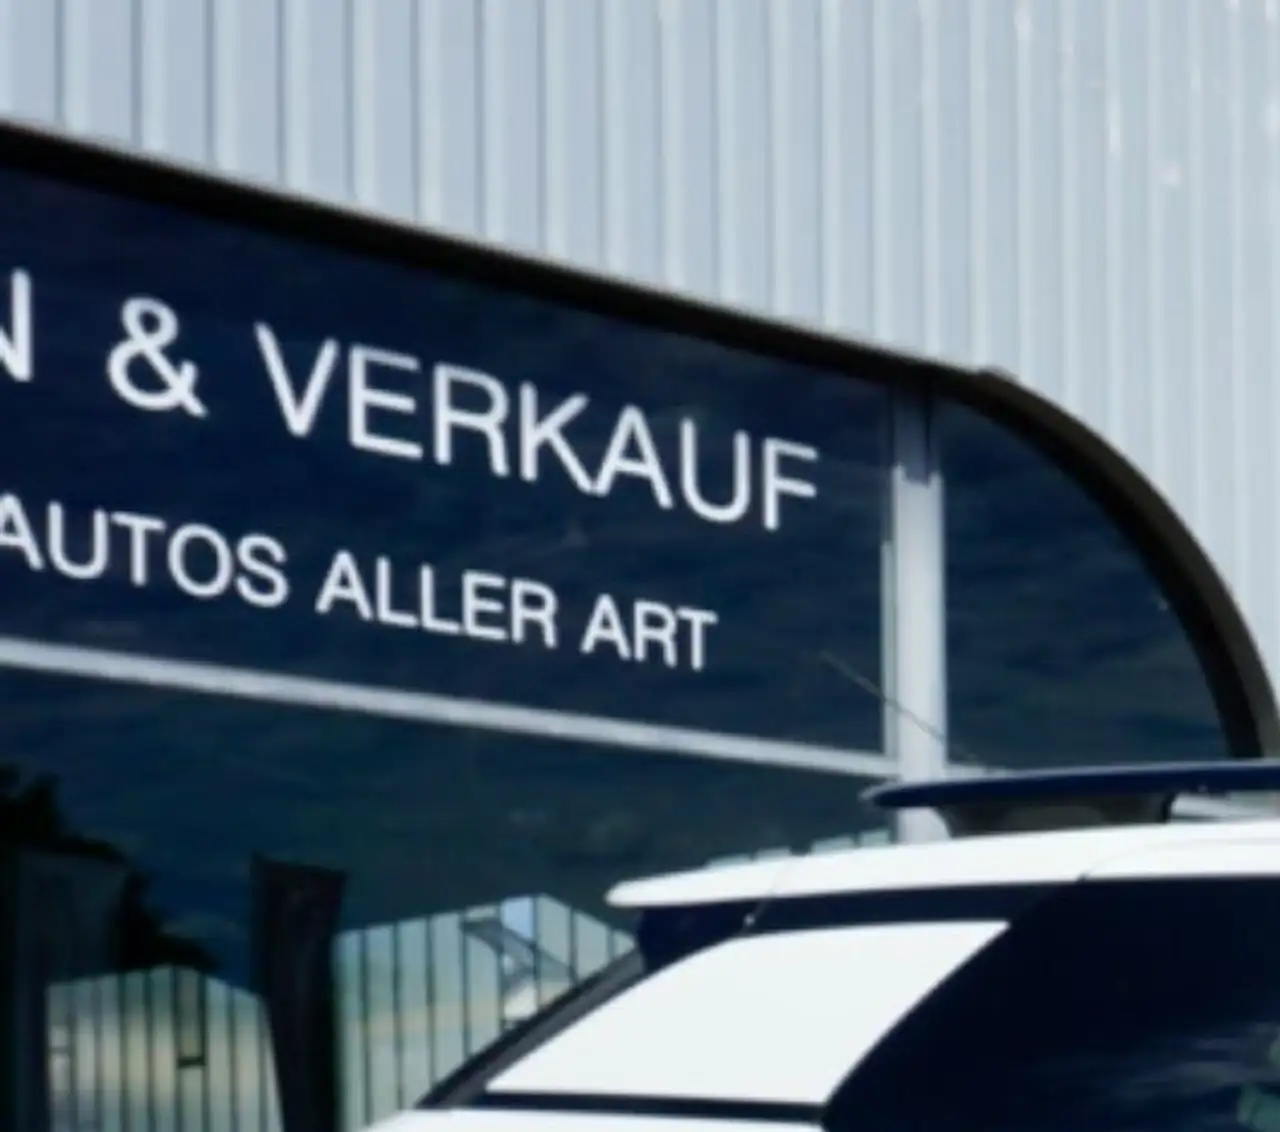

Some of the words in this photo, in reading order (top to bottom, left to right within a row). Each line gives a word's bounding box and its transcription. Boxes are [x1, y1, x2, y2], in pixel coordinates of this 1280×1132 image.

[106, 297, 207, 417] &
[255, 323, 819, 531] VERKAUF
[0, 492, 289, 608] AUTOS
[315, 550, 558, 648] ALLER
[581, 594, 719, 670] ART
